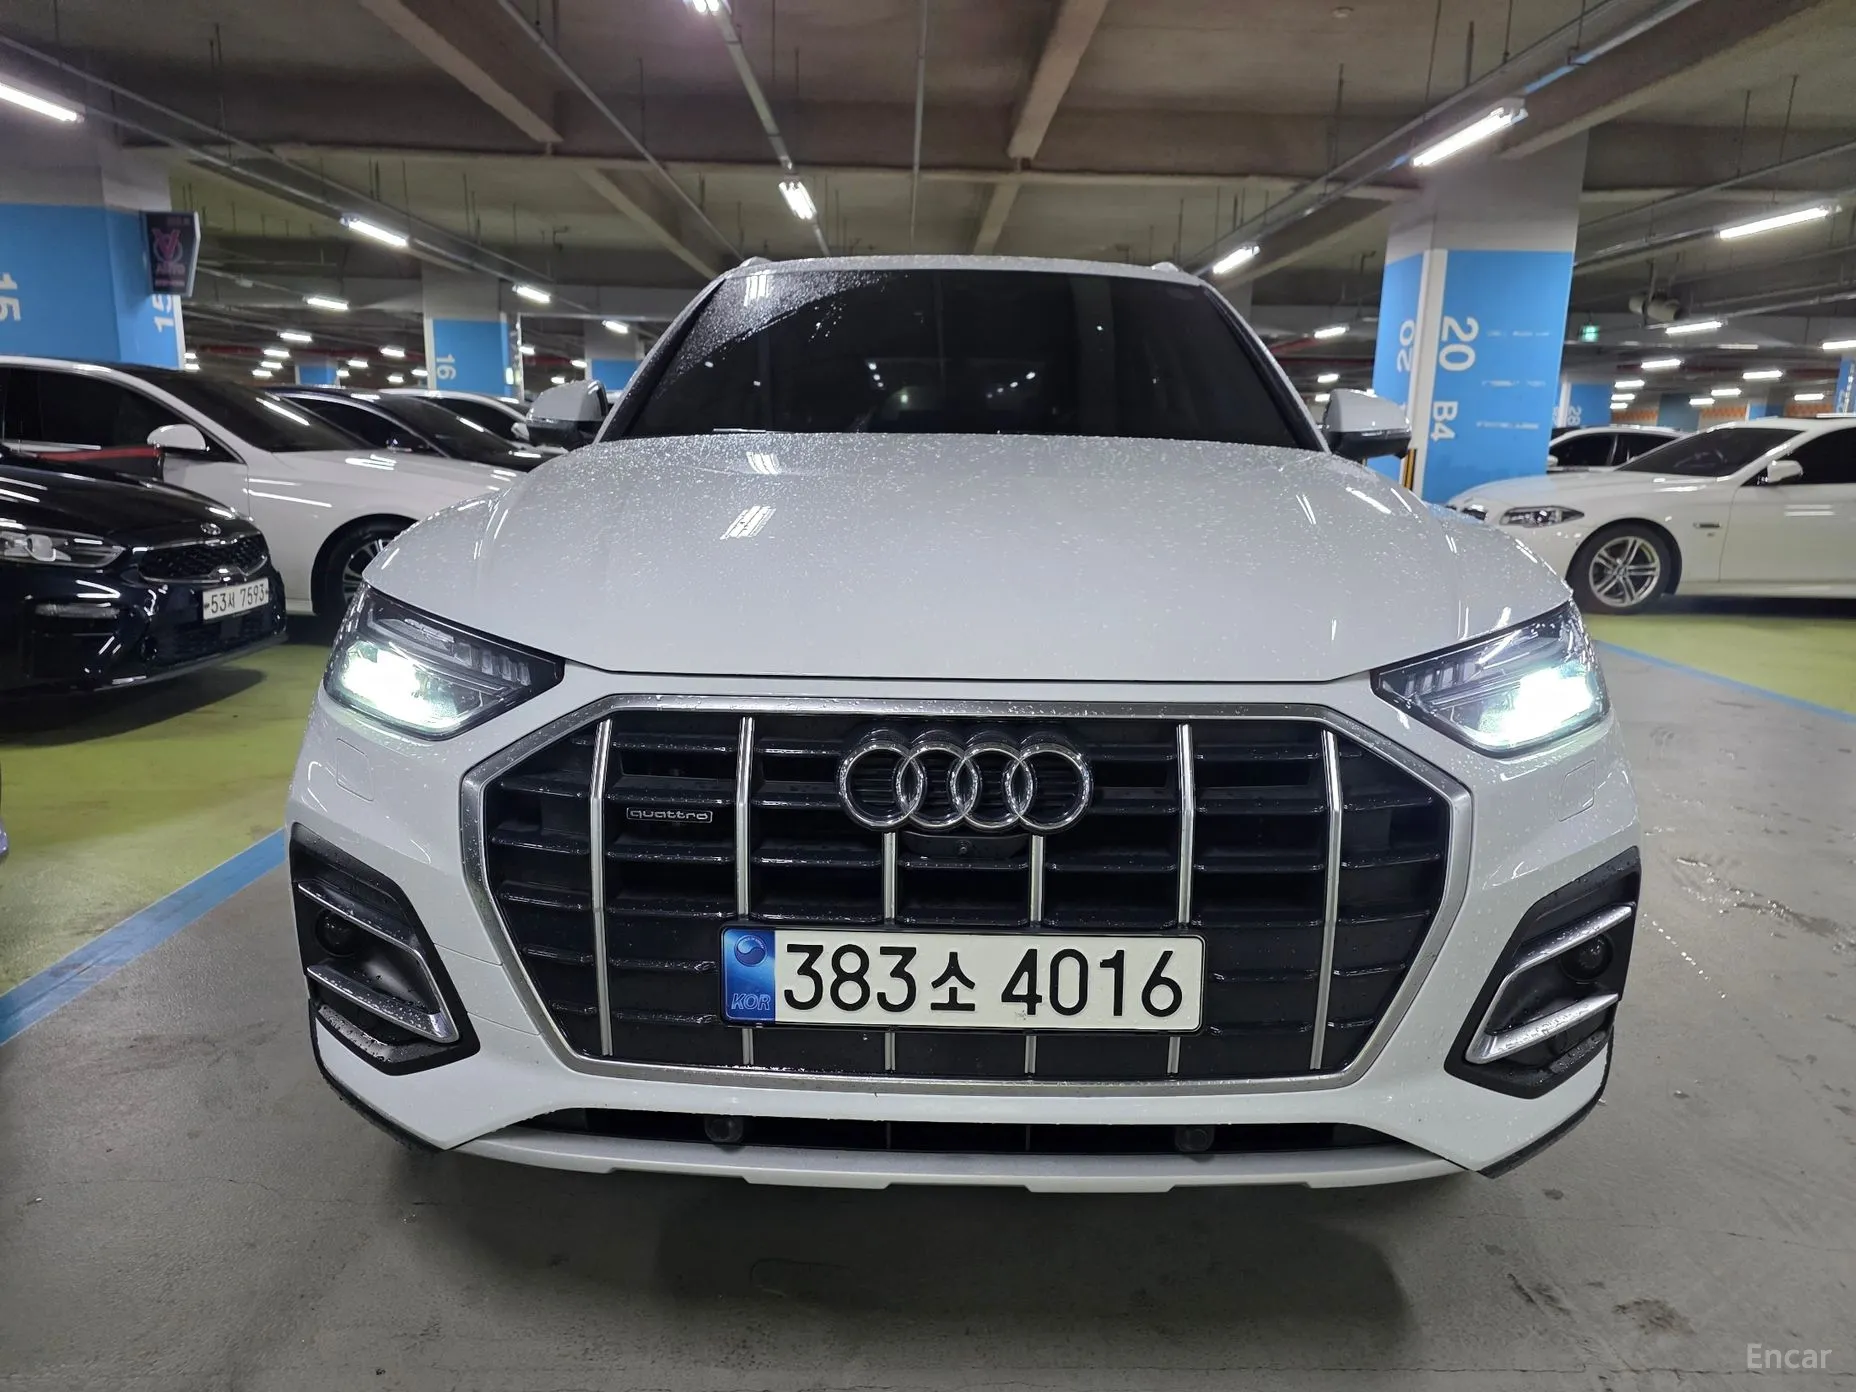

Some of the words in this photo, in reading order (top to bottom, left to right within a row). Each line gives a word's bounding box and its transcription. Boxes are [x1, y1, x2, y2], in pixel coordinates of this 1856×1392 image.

[1438, 316, 1479, 372] 20
[436, 353, 457, 380] 16
[1430, 400, 1459, 442] B4
[239, 583, 265, 608] 7593
[629, 810, 709, 820] quattro
[783, 943, 976, 1013] 383소
[1000, 947, 1184, 1018] 4016
[731, 992, 771, 1011] KOR
